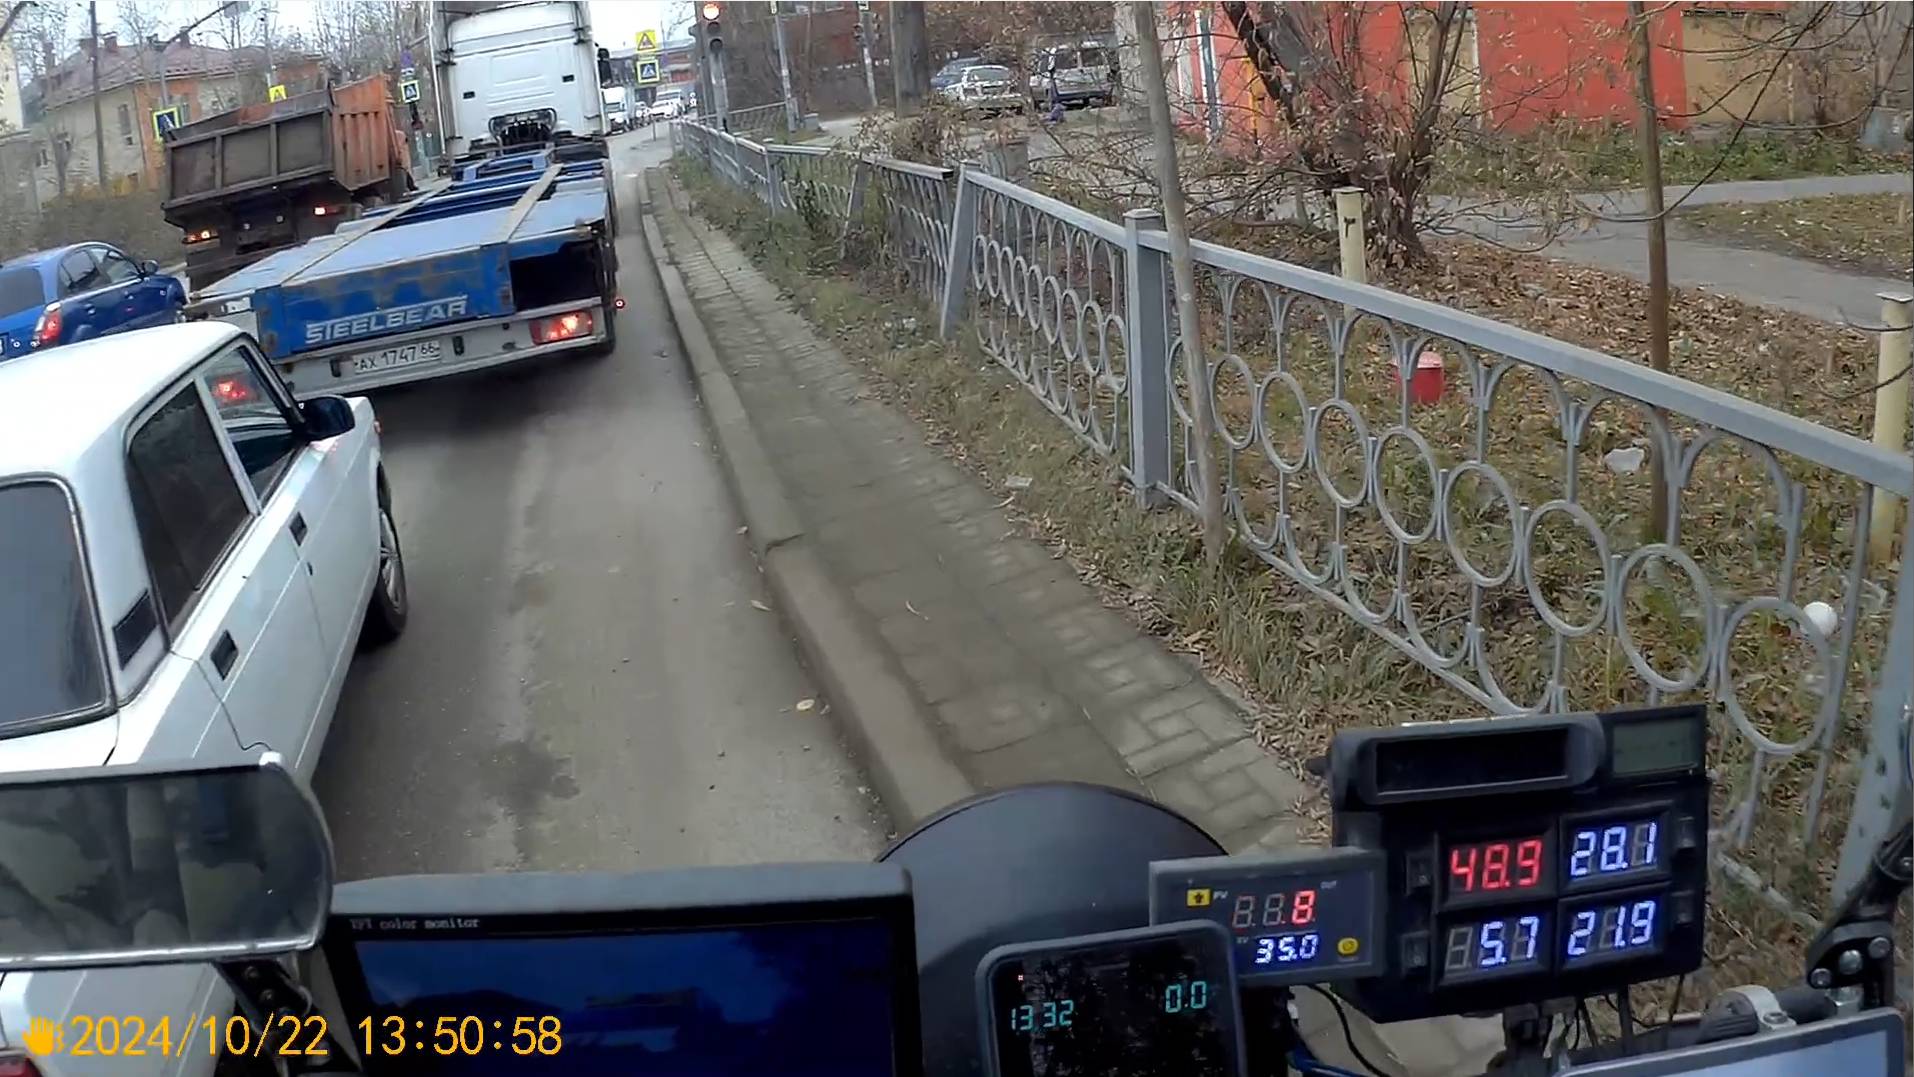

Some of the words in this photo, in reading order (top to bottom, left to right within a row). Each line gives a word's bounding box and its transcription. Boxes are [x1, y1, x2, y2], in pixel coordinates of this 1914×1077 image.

[306, 296, 468, 343] STEELBEAR
[381, 347, 416, 366] 1747
[1451, 840, 1542, 891] 48.9
[1571, 822, 1656, 876] 28.1
[379, 918, 417, 929] color
[424, 917, 480, 929] monitor
[1481, 917, 1539, 965] 5.7
[1568, 901, 1656, 955] 21.9
[1255, 934, 1318, 964] 35.0
[1166, 981, 1206, 1013] 0.0
